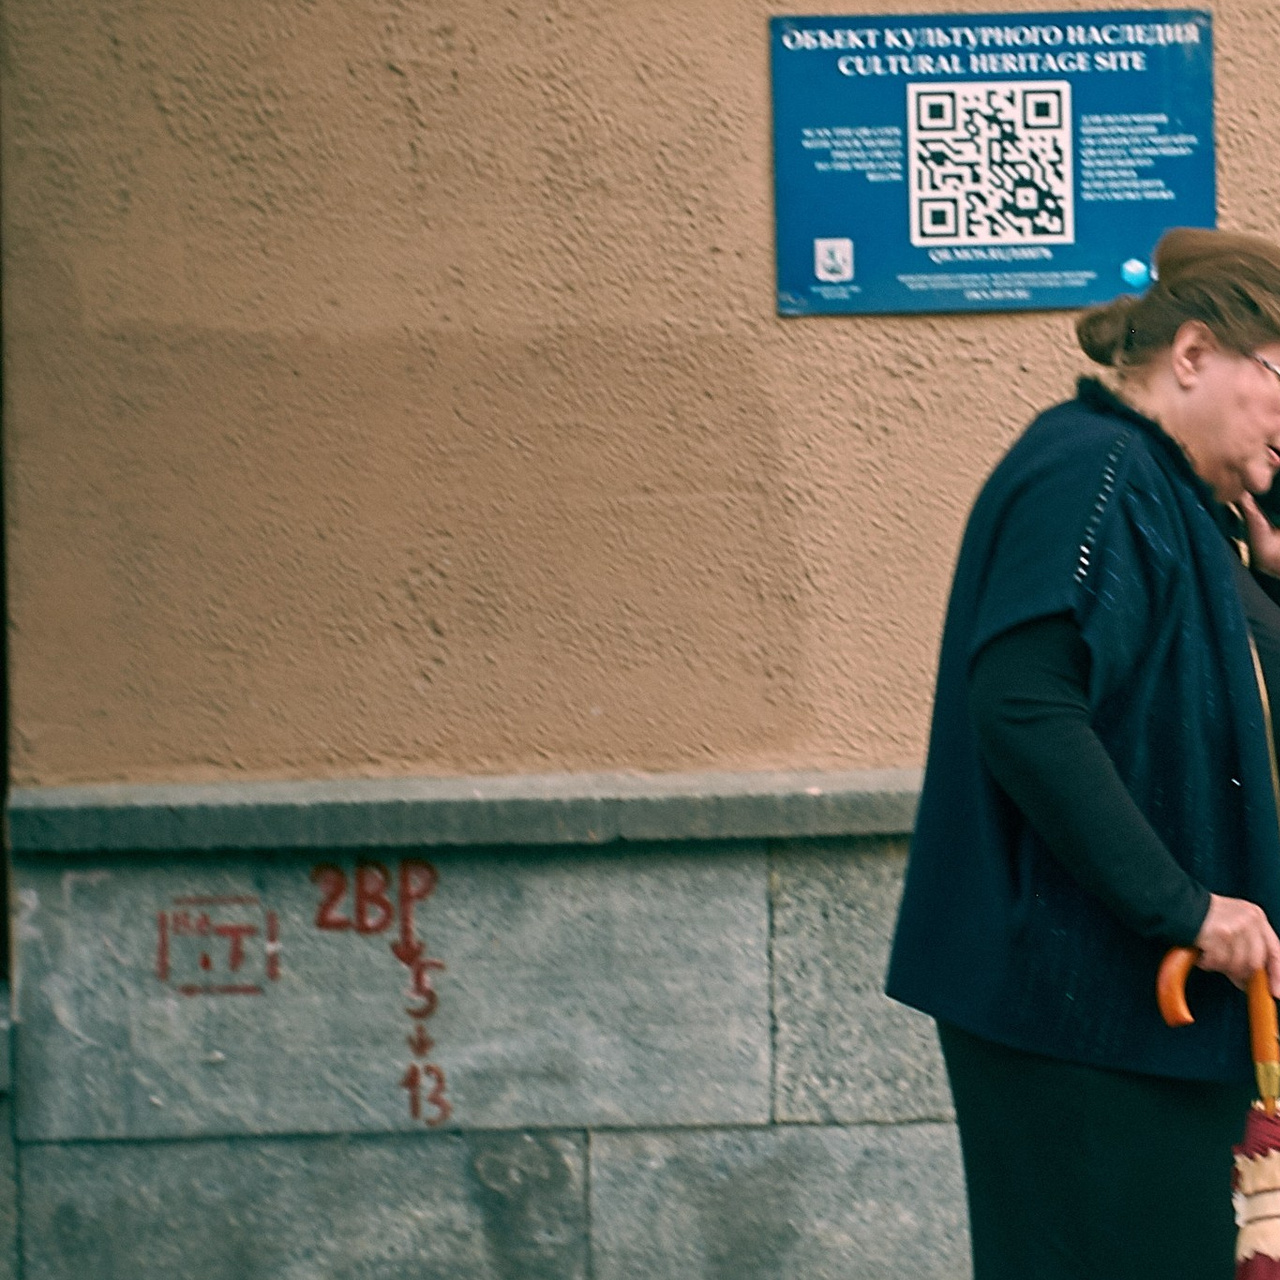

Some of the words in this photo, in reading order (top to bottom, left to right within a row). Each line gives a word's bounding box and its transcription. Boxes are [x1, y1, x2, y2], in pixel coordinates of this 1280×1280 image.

[782, 27, 882, 51] ОБЪЕКТ
[884, 23, 1064, 52] КУЛЬТУРНОГО
[1066, 22, 1201, 47] НАСЛЕДИЯ
[837, 52, 966, 77] CULTURAL
[969, 51, 1093, 75] HERITAGE
[1094, 50, 1149, 72] SITE
[399, 1062, 454, 1128] 13
